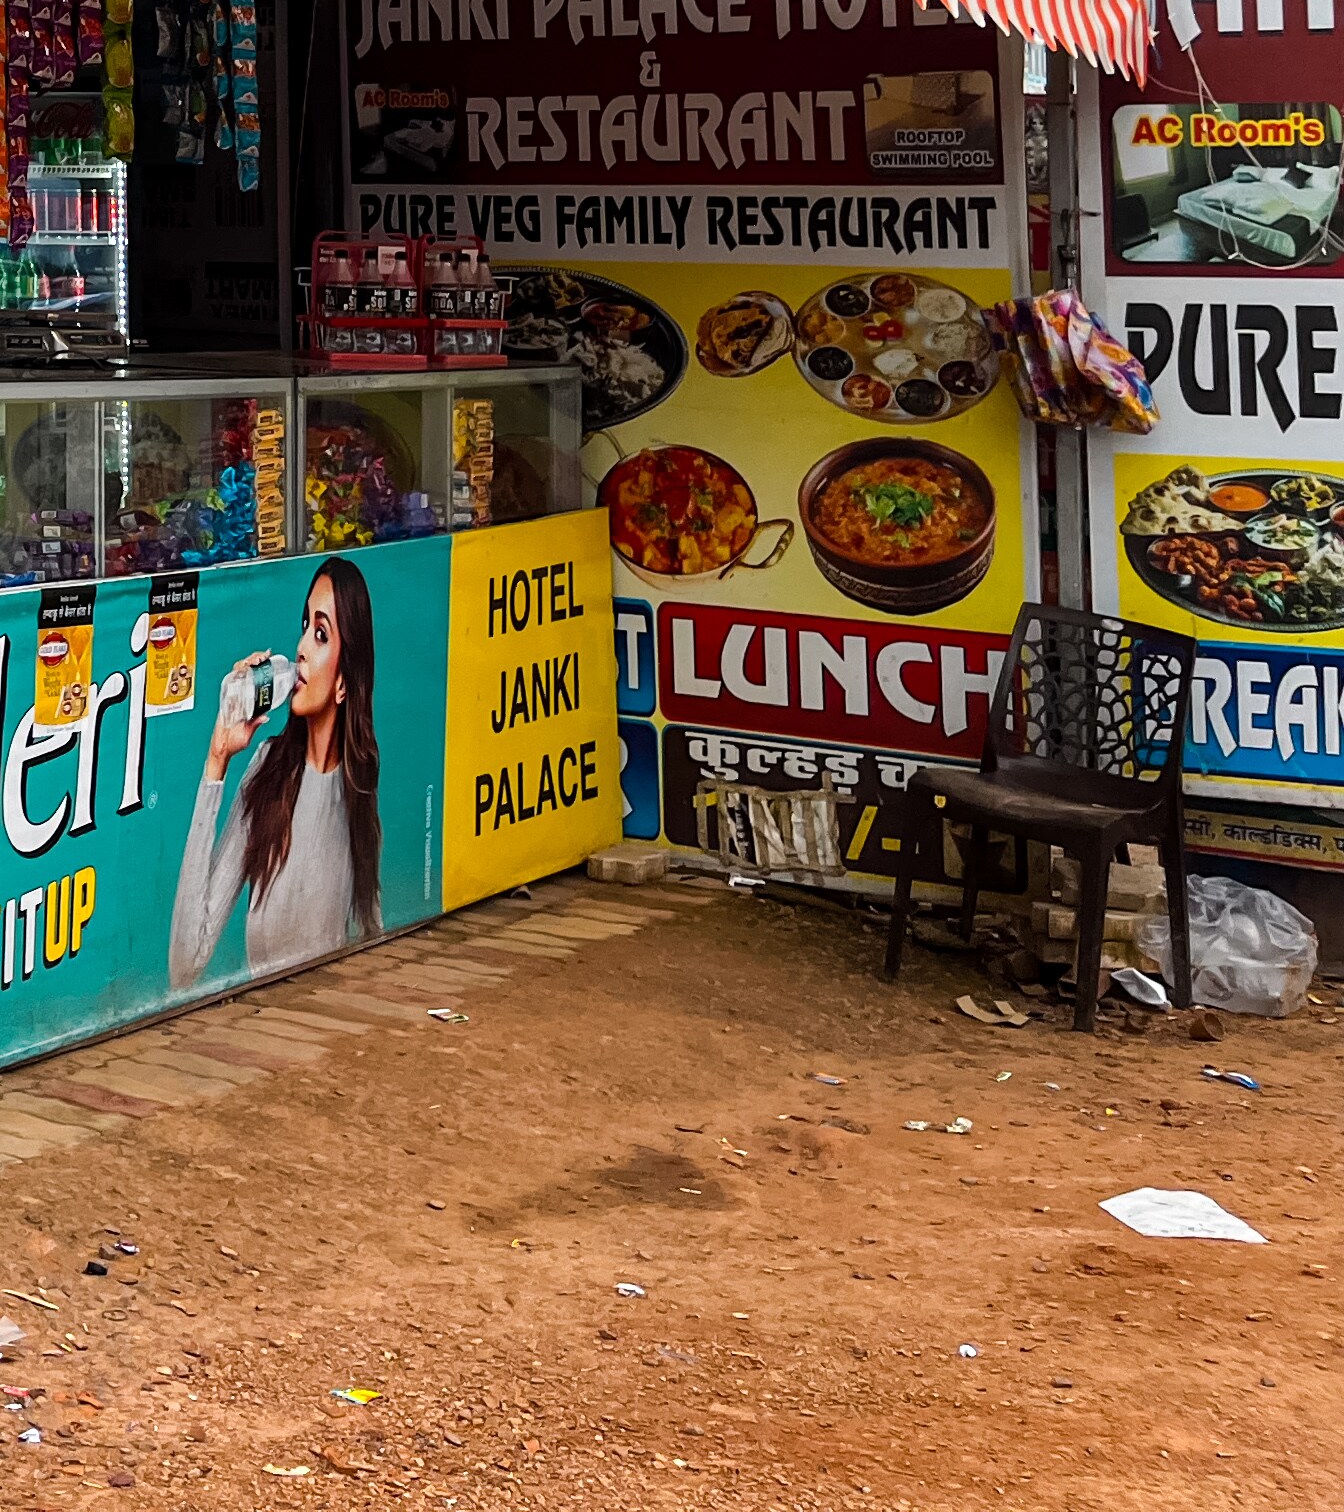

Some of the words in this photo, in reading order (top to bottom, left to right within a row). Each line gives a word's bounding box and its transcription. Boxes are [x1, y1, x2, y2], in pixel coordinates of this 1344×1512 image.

[362, 90, 385, 109] AC
[639, 50, 661, 88] &
[465, 89, 856, 171] RESTAURANT
[870, 150, 949, 169] SWIMMING
[952, 150, 995, 168] POOL
[894, 128, 966, 146] ROOFTOP
[1132, 114, 1182, 146] AC
[1191, 111, 1326, 148] Room's
[360, 192, 458, 246] PURE
[472, 192, 541, 246] VEG
[555, 194, 693, 250] FAMILY
[707, 195, 997, 255] RESTAURANT
[1124, 302, 1343, 434] PURE
[488, 560, 585, 638] HOTEL
[491, 651, 582, 733] JANKI
[672, 618, 1014, 738] LUNCH
[474, 740, 600, 837] PALACE
